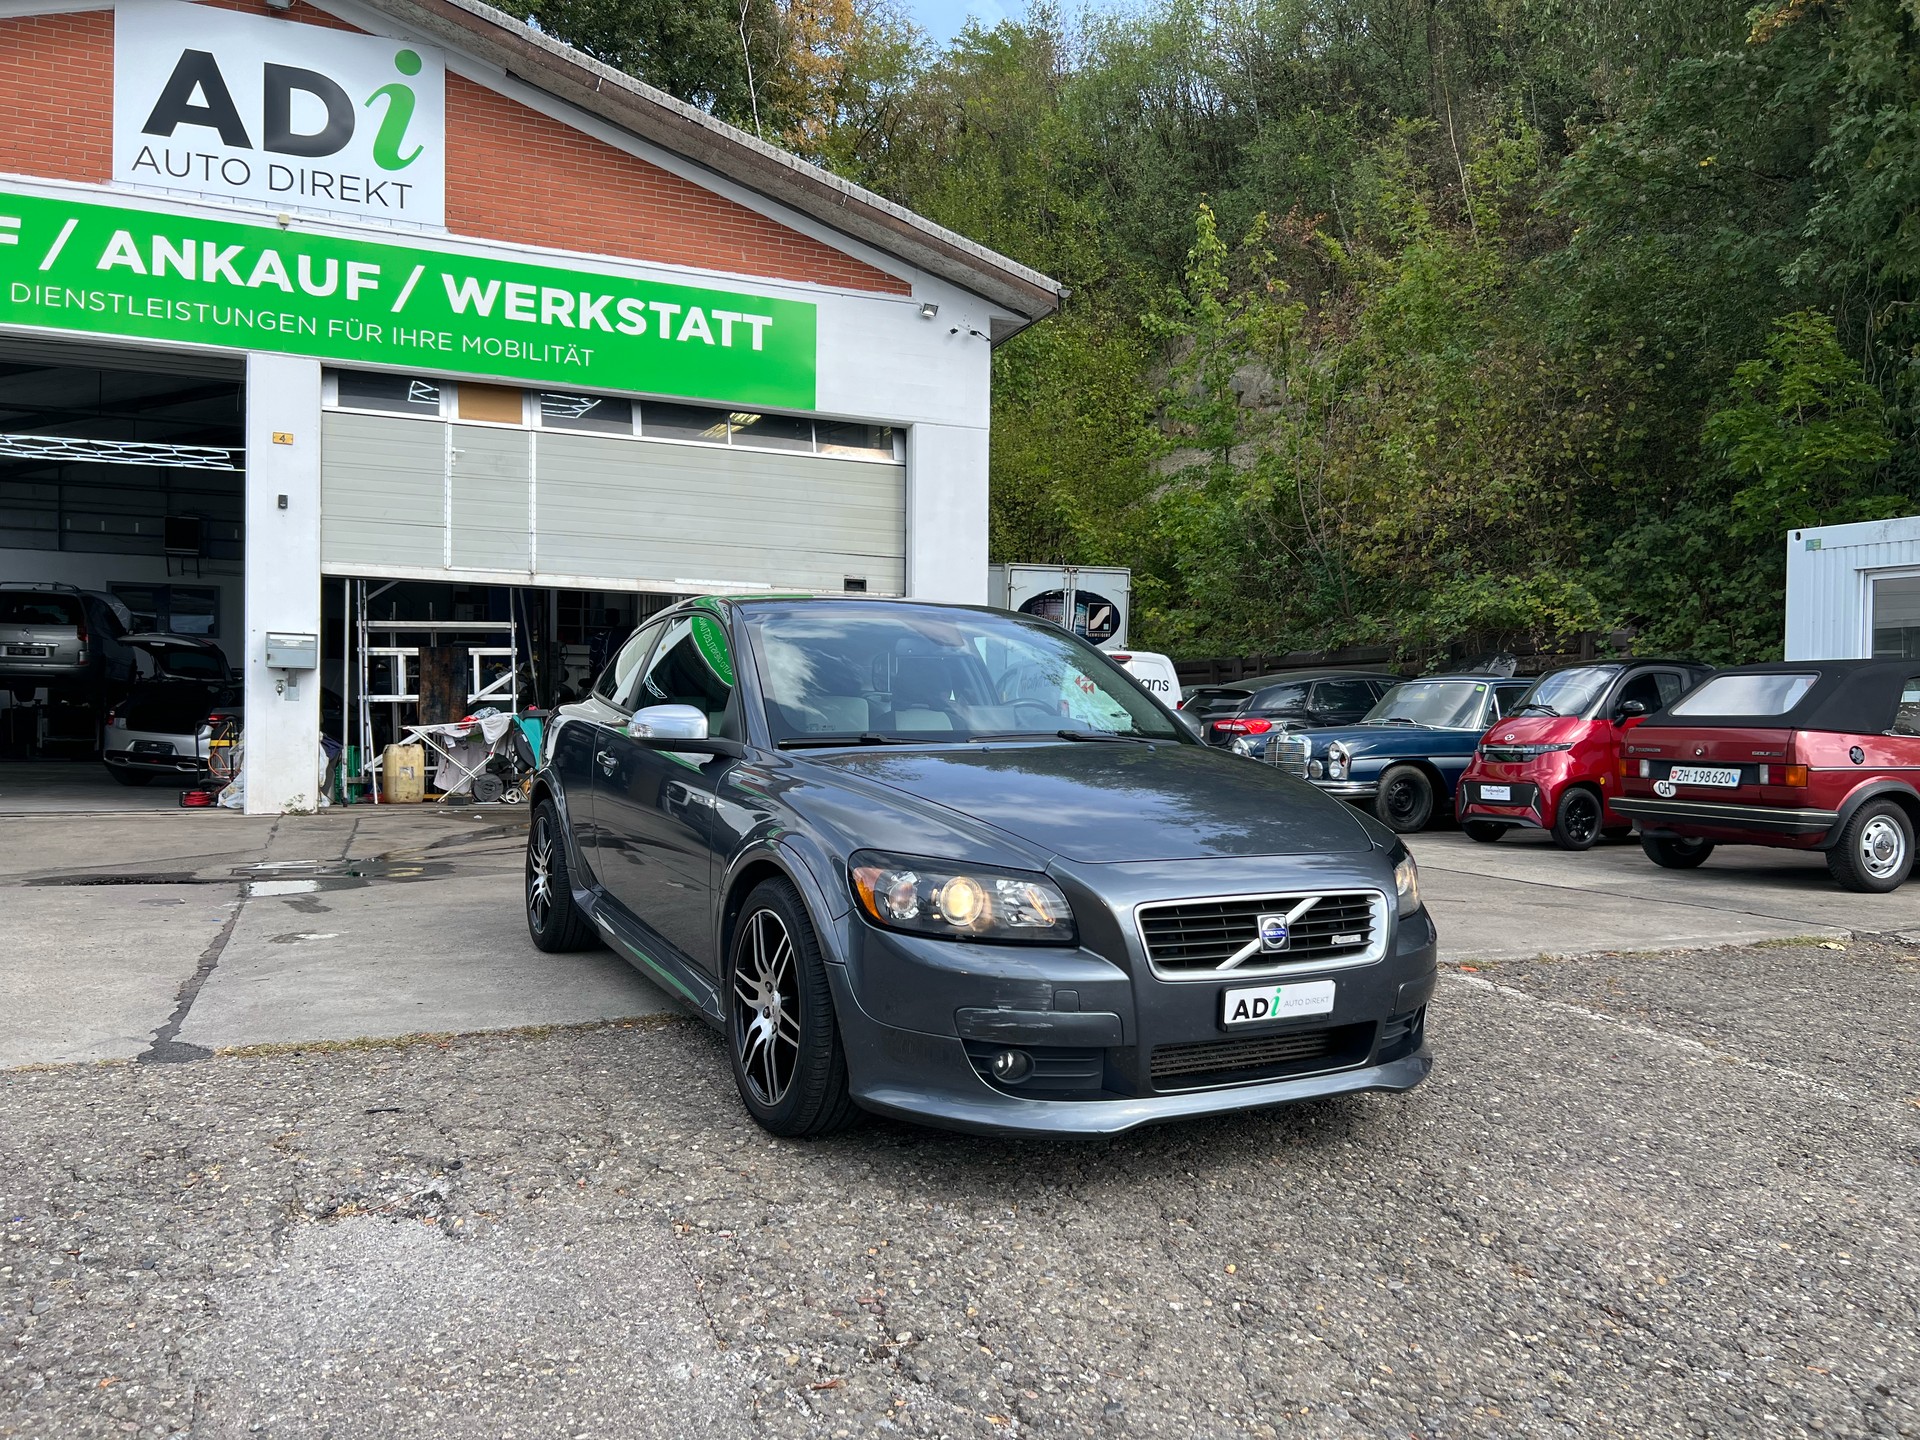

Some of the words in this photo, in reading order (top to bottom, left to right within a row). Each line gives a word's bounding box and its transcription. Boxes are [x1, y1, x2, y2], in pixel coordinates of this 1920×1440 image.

[141, 48, 424, 171] ADi
[131, 145, 251, 186] AUTO
[269, 164, 413, 209] DIREKT
[96, 229, 381, 302] ANKAUF
[441, 273, 773, 351] WERKSTATT
[11, 282, 316, 336] DIENSTLEISTUNGEN
[328, 318, 383, 344] FÜR
[393, 327, 453, 352] IHRE
[462, 334, 595, 367] MOBILITÄT
[279, 434, 286, 443] 4
[1658, 781, 1671, 795] CH
[1232, 987, 1281, 1020] ADi
[1283, 999, 1304, 1007] AUTO
[1304, 996, 1329, 1005] DIREKT
